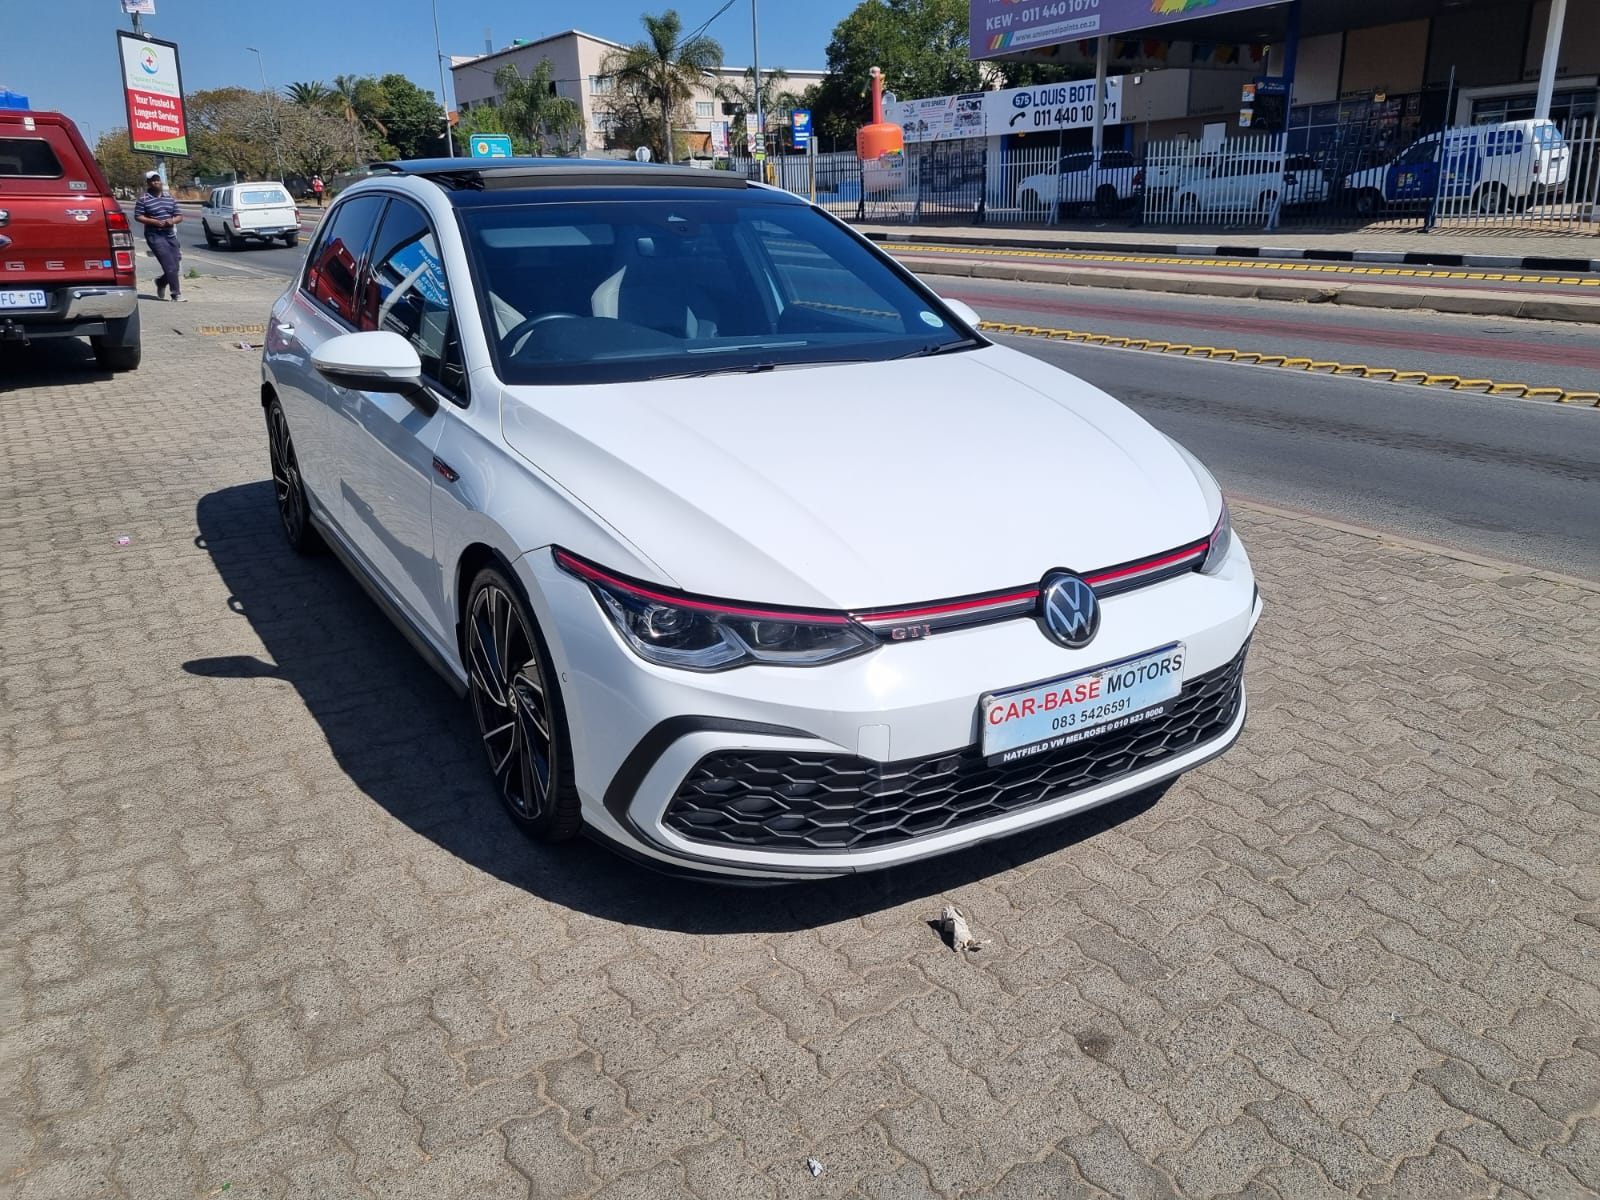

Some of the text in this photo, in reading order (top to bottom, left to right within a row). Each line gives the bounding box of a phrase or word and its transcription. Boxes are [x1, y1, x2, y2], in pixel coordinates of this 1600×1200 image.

[986, 13, 1013, 31] KEW
[1022, 7, 1040, 23] 011
[1042, 2, 1066, 18] 440
[1068, 0, 1099, 13] 1070
[134, 94, 176, 109] Your Trusted &
[1015, 82, 1108, 107] 575 LOUIS BOT
[134, 106, 179, 124] Longest Serving
[1033, 109, 1052, 126] 011
[1054, 106, 1078, 123] 440
[136, 119, 180, 136] Local Pharmacy
[0, 292, 43, 305] FC GP
[891, 624, 931, 640] GTI
[989, 654, 1182, 726] CAR-BASE MOTORS
[1052, 697, 1131, 731] 083 5426591
[1003, 742, 1048, 762] HATFIELD
[1050, 737, 1065, 748] VW
[1066, 725, 1106, 745] MELROSE
[1114, 719, 1129, 729] 010
